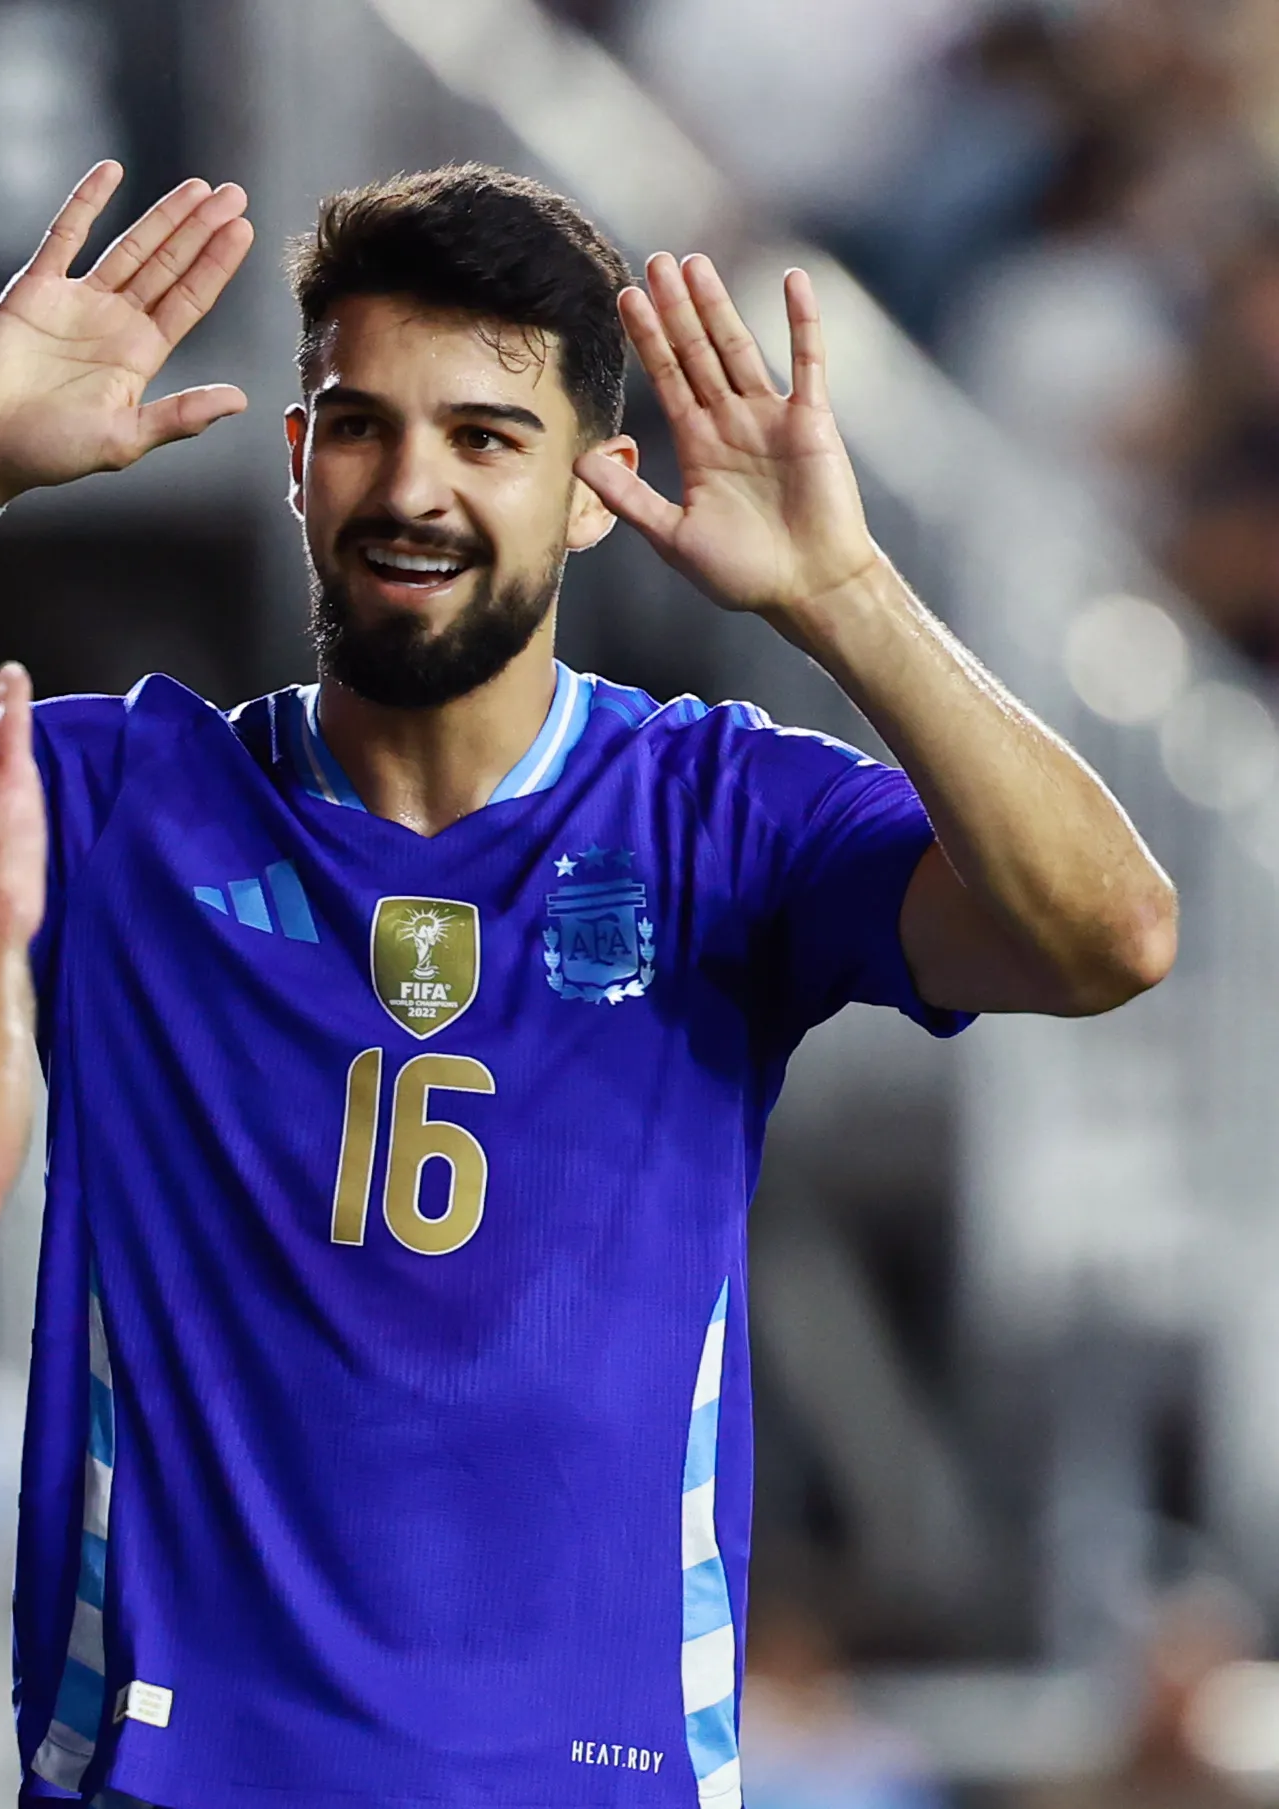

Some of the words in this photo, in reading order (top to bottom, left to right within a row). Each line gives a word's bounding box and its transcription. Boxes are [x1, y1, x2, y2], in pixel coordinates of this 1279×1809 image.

[568, 912, 632, 966] AFA
[389, 999, 414, 1007] WORLD
[415, 1000, 458, 1008] CHAMPIONS
[408, 1007, 437, 1018] 2022
[330, 1046, 496, 1256] 16
[571, 1739, 664, 1774] HEAT.RDY
